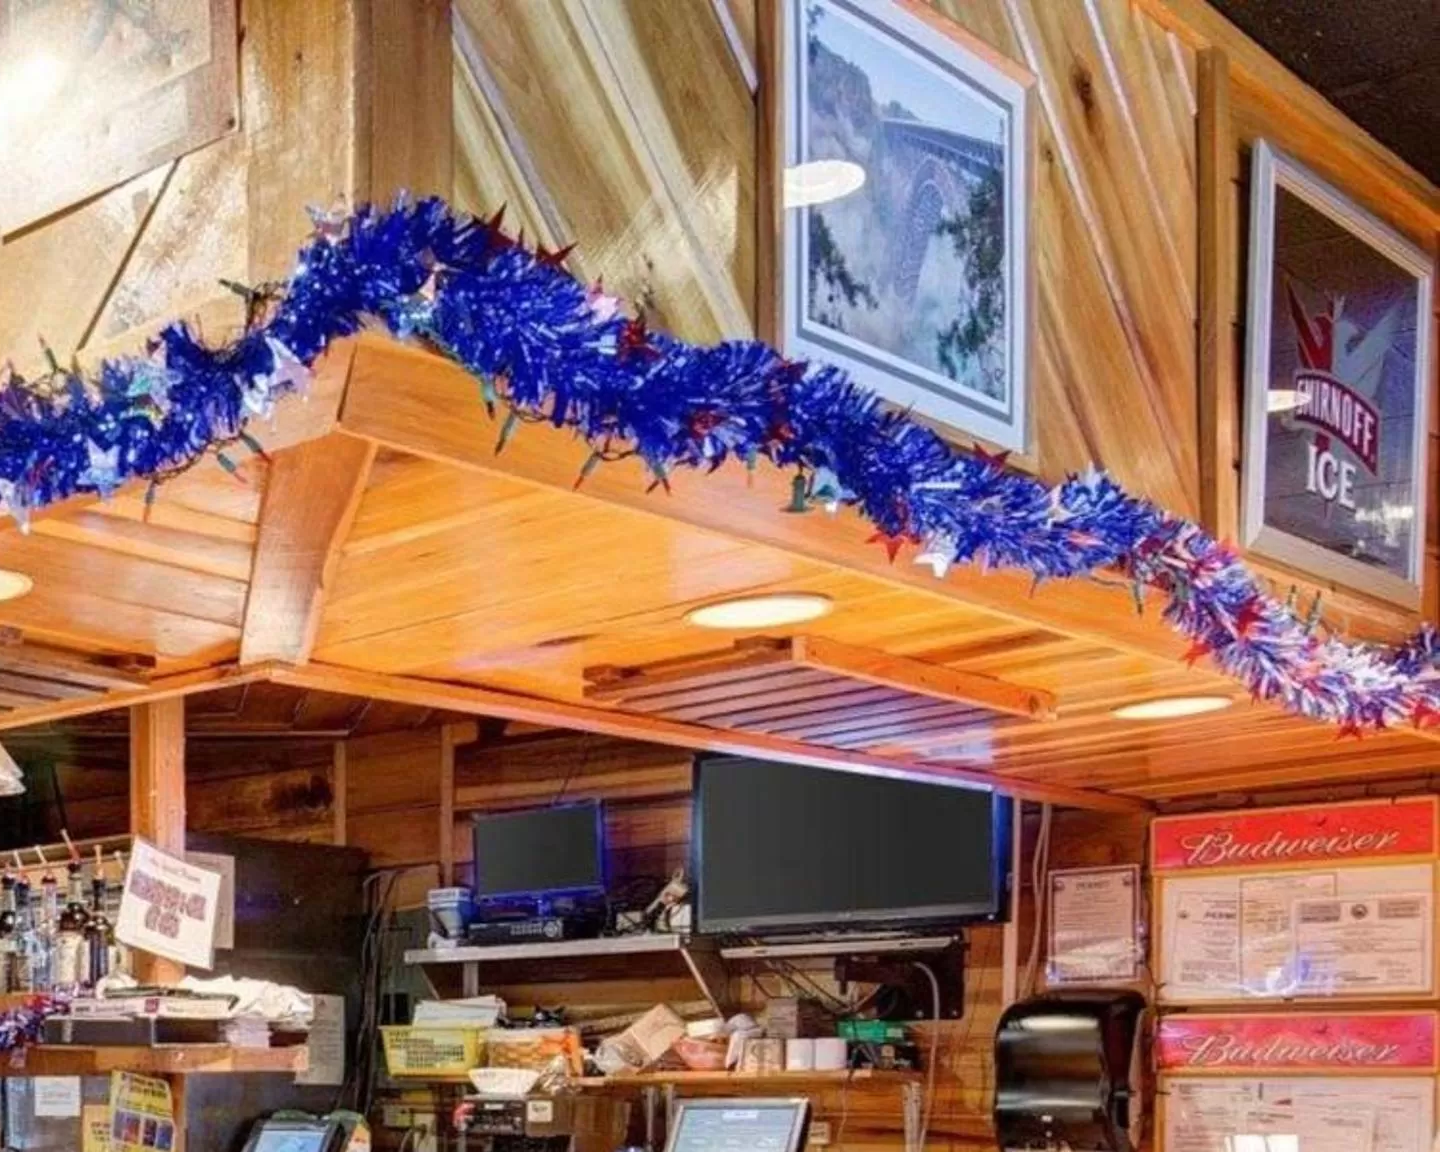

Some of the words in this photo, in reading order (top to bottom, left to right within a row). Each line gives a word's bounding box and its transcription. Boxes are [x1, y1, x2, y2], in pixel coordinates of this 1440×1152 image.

[1297, 377, 1373, 456] SMIRNOFF
[1307, 443, 1357, 510] ICE
[1181, 827, 1400, 866] Budweiser
[1183, 1033, 1401, 1066] Budweiser
